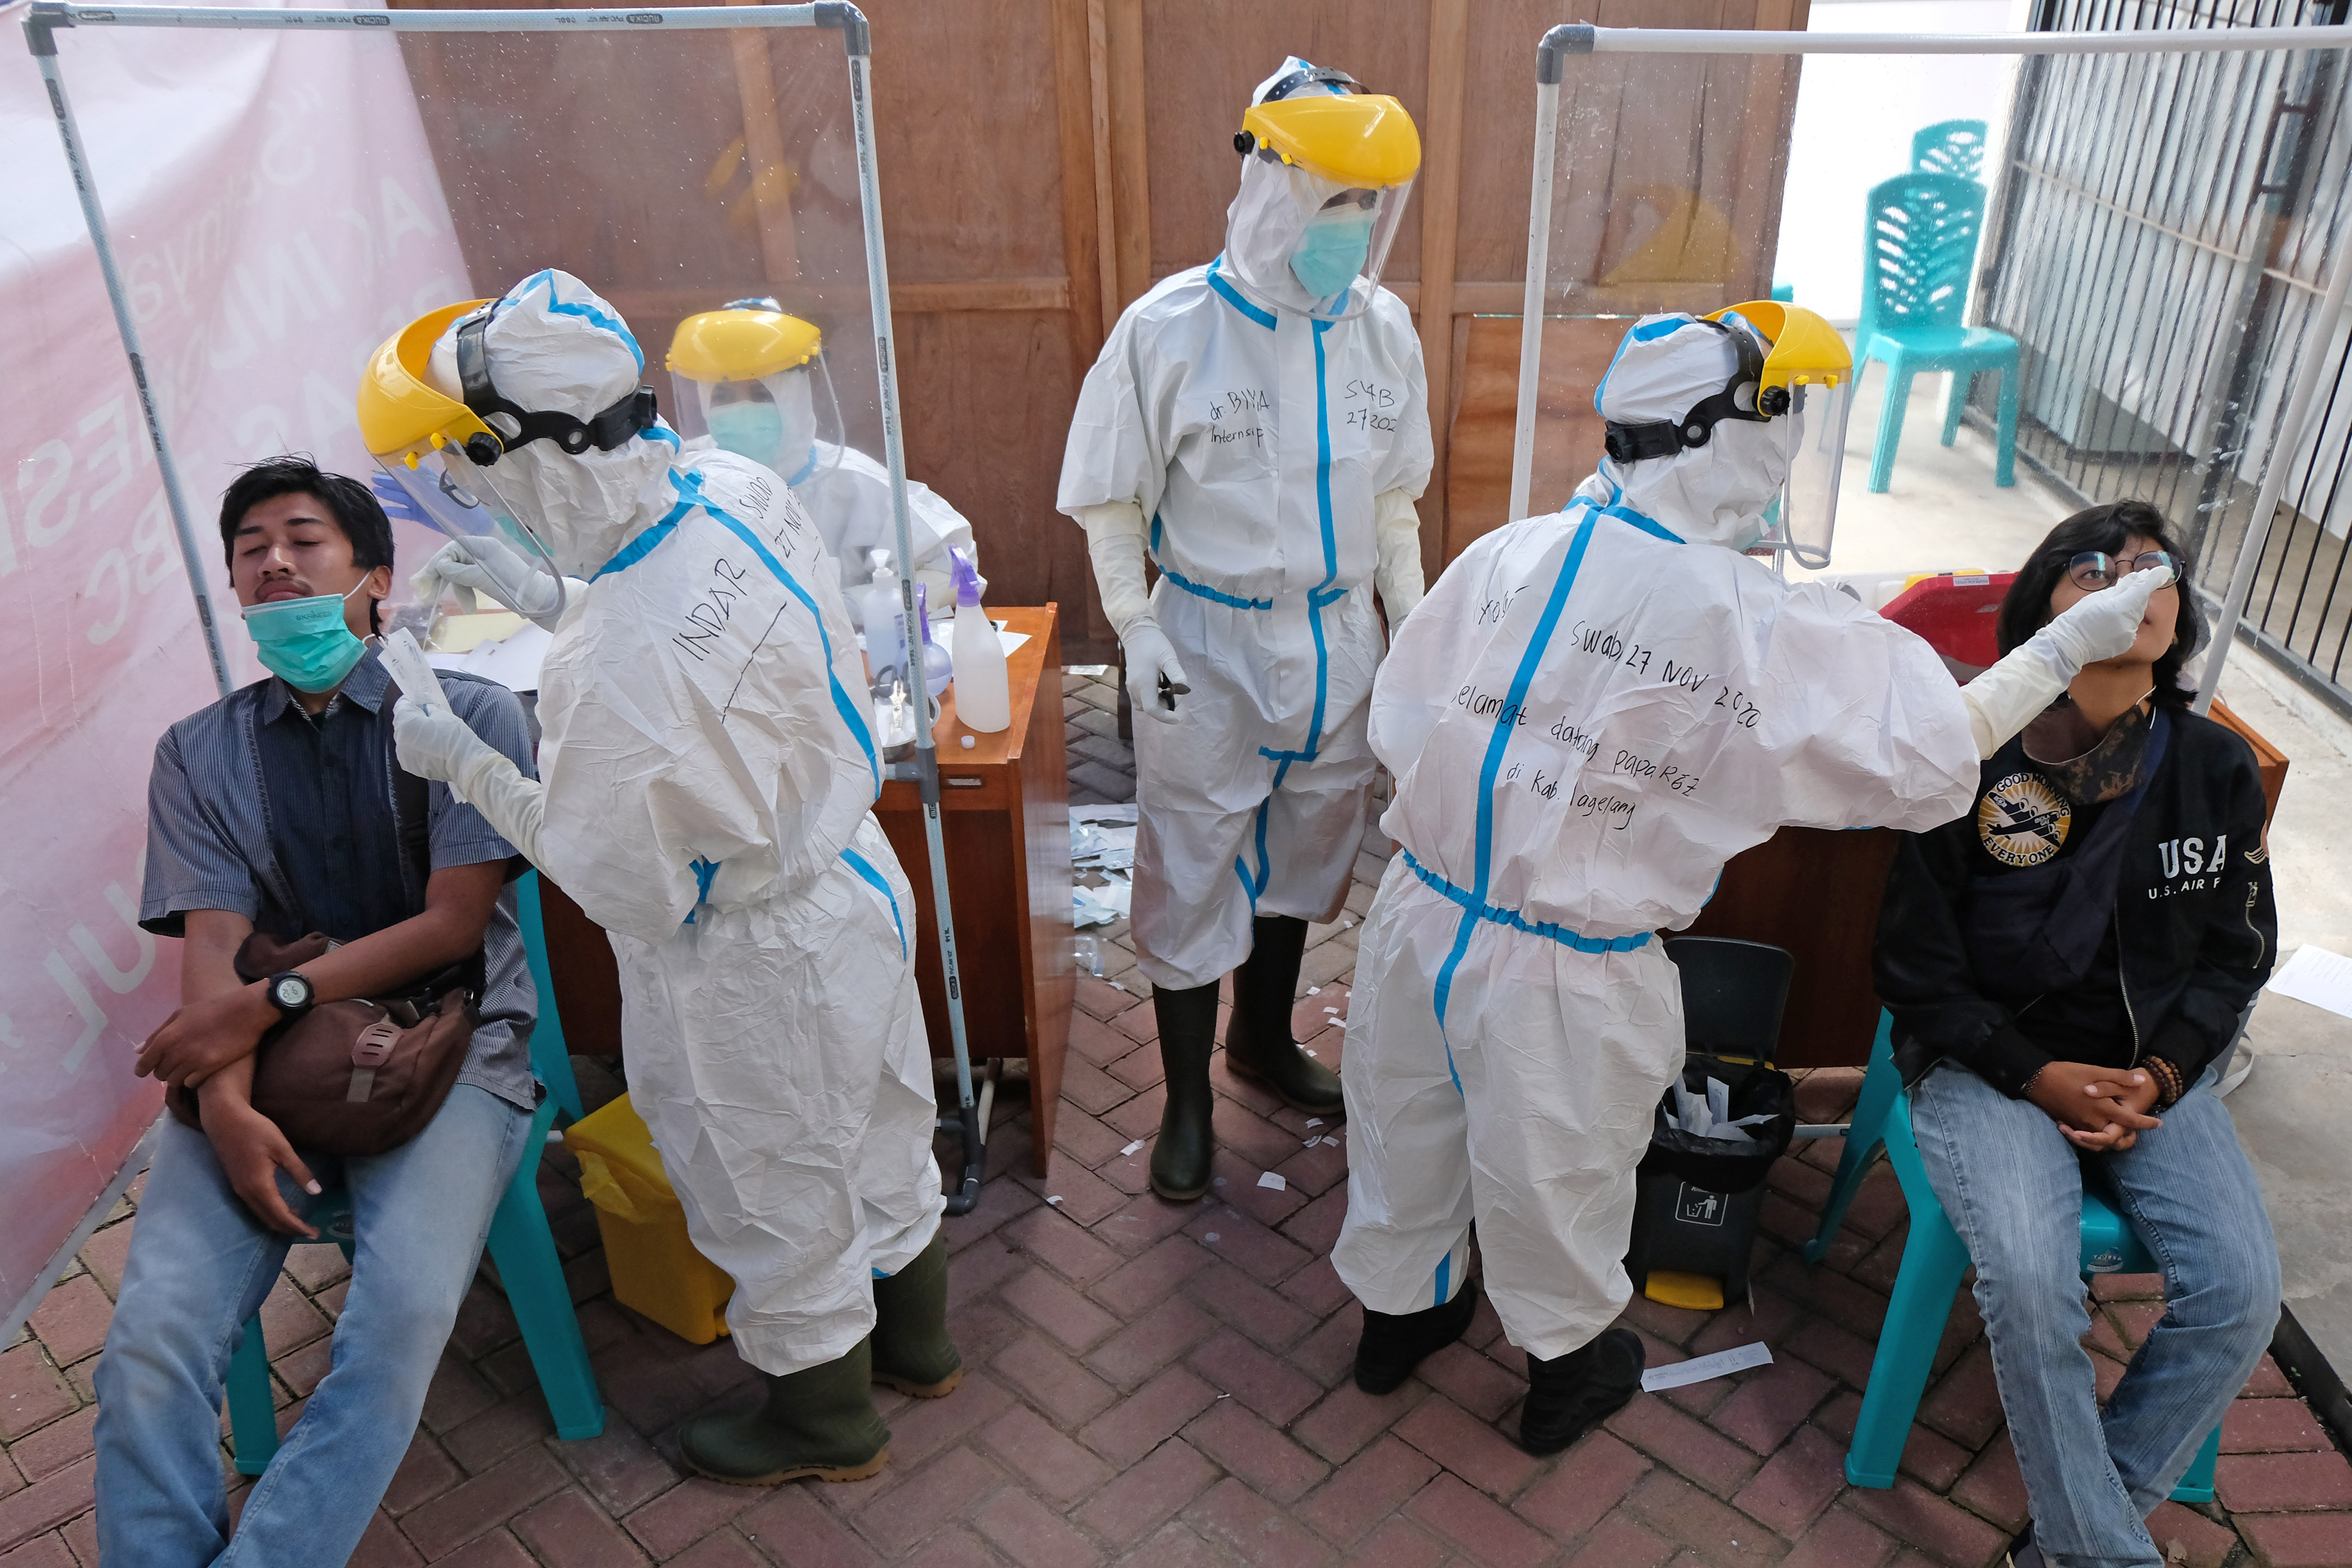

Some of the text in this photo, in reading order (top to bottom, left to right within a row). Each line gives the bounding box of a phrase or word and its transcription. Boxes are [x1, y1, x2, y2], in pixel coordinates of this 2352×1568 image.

[356, 16, 389, 25] RUCIKA
[628, 15, 661, 23] RUCIKA
[1211, 425, 1264, 448] Internsip
[774, 528, 796, 558] 27
[672, 558, 748, 661] INDAR
[1626, 645, 1652, 674] 27
[1663, 660, 1709, 692] NOV
[1715, 686, 1762, 728] 2020
[1450, 685, 1527, 726] elamat
[1551, 716, 1600, 764] datang
[1506, 762, 1525, 780] di
[1570, 781, 1637, 830] agelang
[1996, 772, 2070, 817] GOOD MORNING
[2158, 834, 2226, 879] USA
[2181, 879, 2205, 892] AIR
